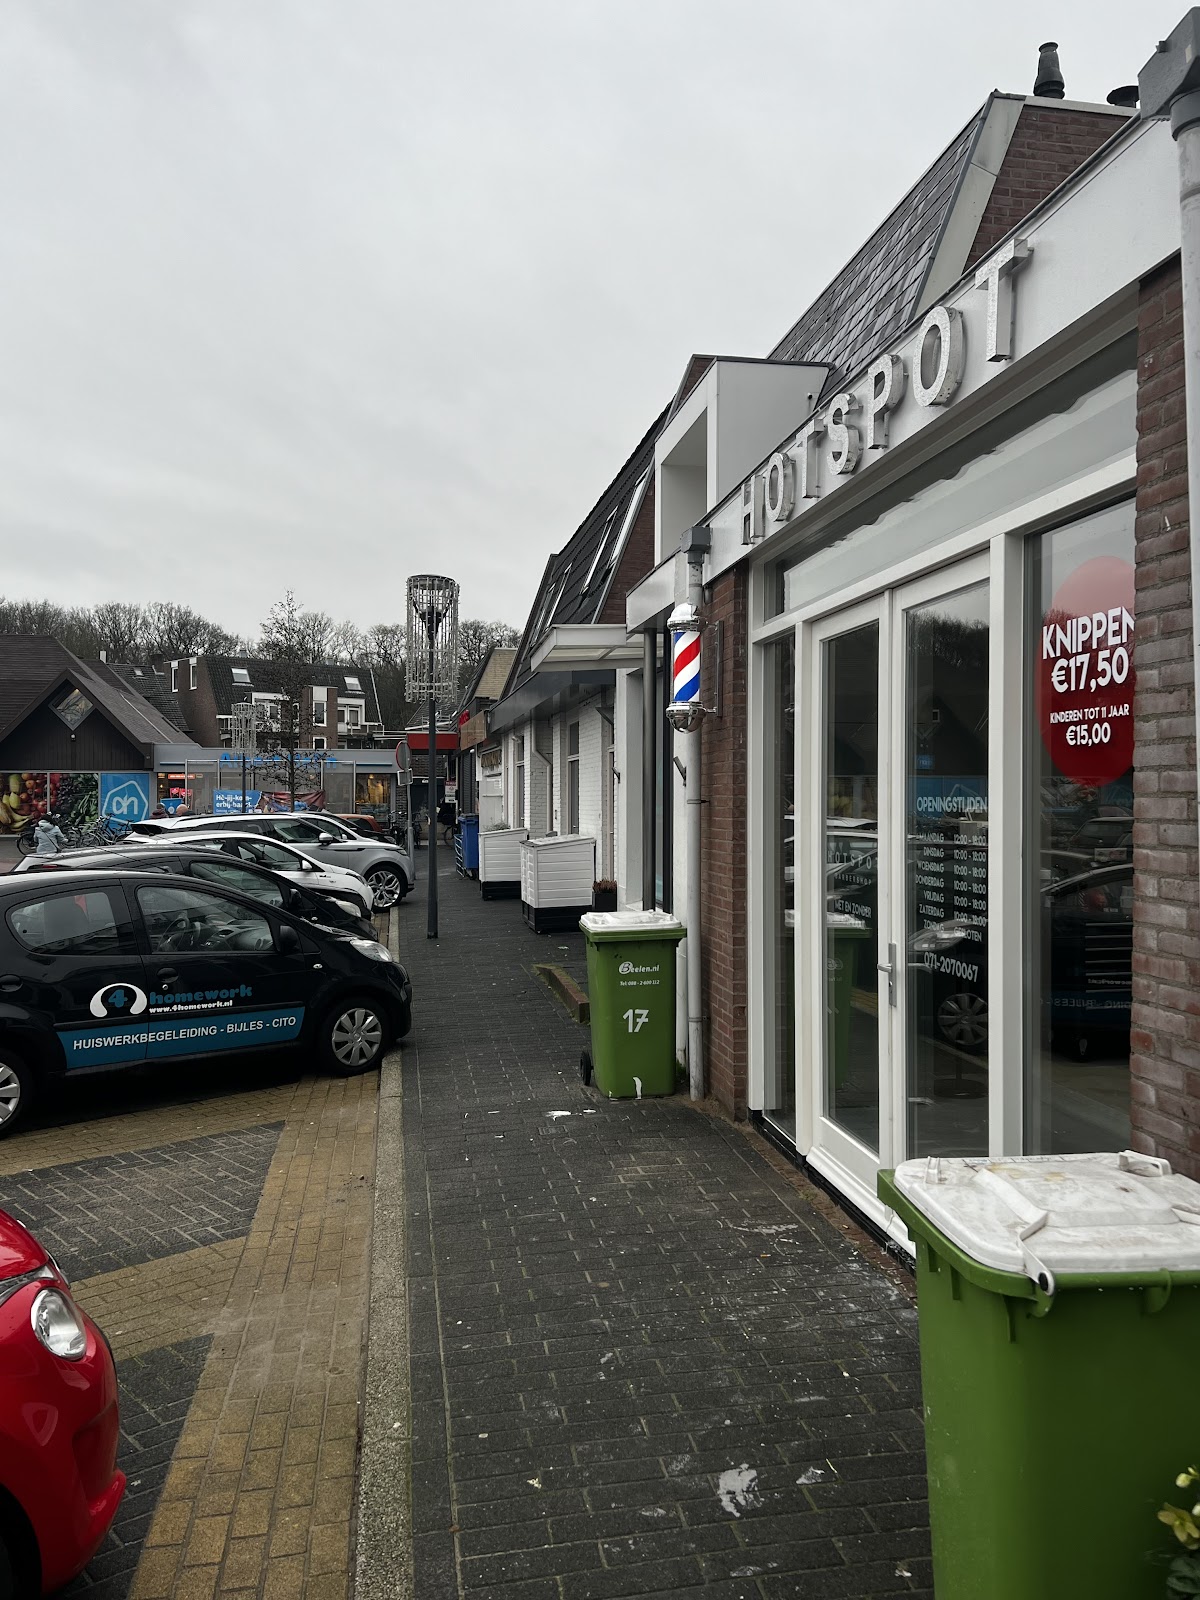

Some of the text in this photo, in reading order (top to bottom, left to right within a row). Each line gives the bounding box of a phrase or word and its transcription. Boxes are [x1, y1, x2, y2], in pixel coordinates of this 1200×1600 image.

[740, 237, 1034, 546] HOTSPOT
[1042, 606, 1135, 660] KNIPPEN
[1051, 646, 1129, 693] €17,50
[1050, 704, 1130, 724] KINDEREN TOT 11 JAAR
[1066, 722, 1111, 746] €15,00
[916, 796, 988, 814] OPENINGSTIJDEN
[827, 851, 878, 870] HOTSPO
[923, 847, 944, 858] DINSDAG
[917, 860, 944, 873] WOENSDAG
[915, 875, 944, 888] DONDERDAG
[923, 890, 944, 903] VRIJDAG
[919, 904, 944, 918] ZATERDAG
[618, 961, 660, 975] Beelen.nl
[924, 952, 979, 983] 071-2070067
[108, 984, 253, 1008] 4 homework
[149, 1000, 233, 1014] www.4homework.nl
[622, 1009, 649, 1033] 17
[73, 1025, 218, 1050] HUISWERKBEGELEIDING
[226, 1020, 264, 1033] BIJLES
[272, 1016, 297, 1028] CITO
